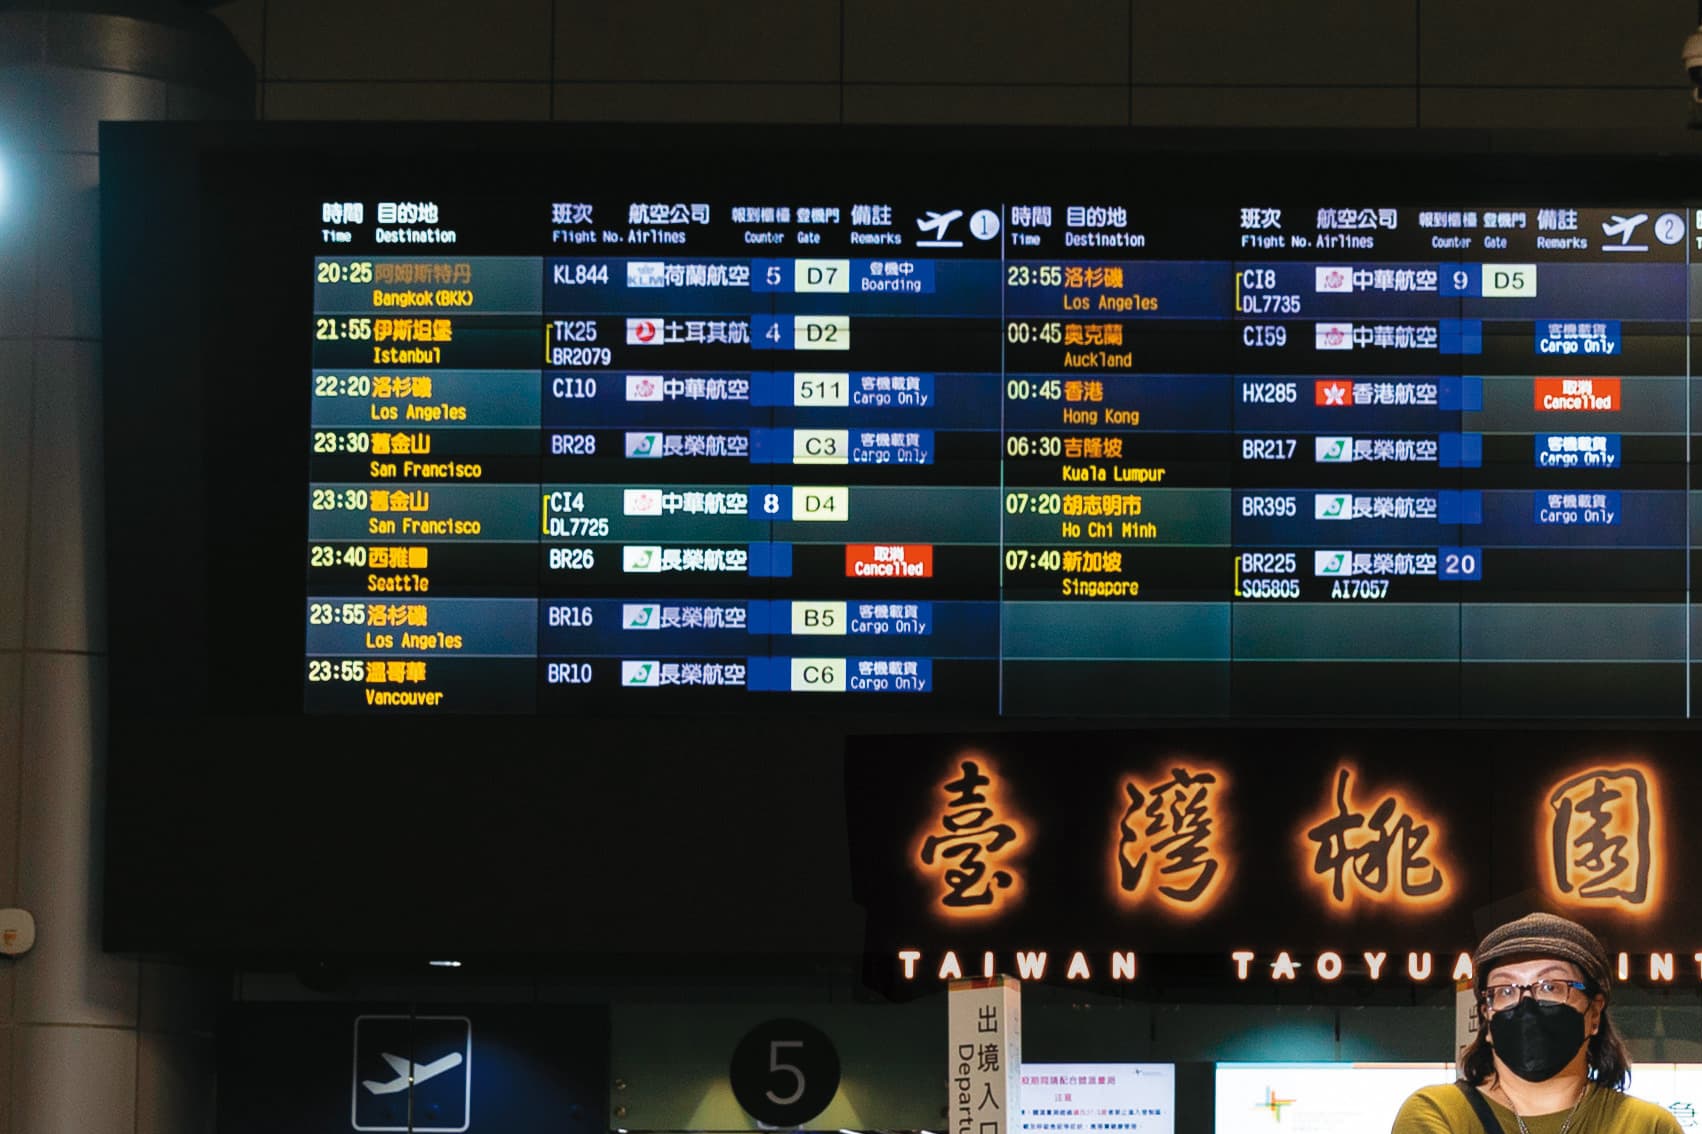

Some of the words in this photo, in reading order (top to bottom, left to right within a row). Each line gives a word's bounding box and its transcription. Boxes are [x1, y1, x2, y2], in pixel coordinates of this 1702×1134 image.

[322, 202, 364, 225] 時間
[377, 201, 439, 224] 目的地
[551, 203, 593, 225] 班次
[628, 203, 710, 225] 航空公司
[796, 207, 840, 224] 登機門
[850, 204, 892, 226] 備註
[321, 229, 352, 243] Time
[375, 227, 457, 244] Destination
[552, 229, 597, 244] Flight
[602, 230, 624, 243] No.
[627, 228, 686, 244] Airlines
[744, 230, 785, 244] Counter
[797, 231, 821, 244] Gate
[850, 231, 902, 245] Remarks
[317, 262, 373, 283] 20:25
[553, 264, 609, 285] KL844
[665, 265, 750, 287] 荷蘭航空
[766, 266, 781, 285] 5
[806, 266, 838, 285] D7
[1007, 266, 1062, 286] 23:55
[1064, 267, 1123, 288] 洛杉磯
[1243, 269, 1276, 290] CI8
[1353, 269, 1438, 292] 中華航空
[1453, 270, 1468, 290] 9
[1494, 272, 1525, 290] D5
[861, 276, 922, 293] Boarding
[373, 289, 474, 308] Bangkok(BKK)
[1063, 294, 1090, 310] Los
[1098, 294, 1158, 312] Angeles
[1242, 294, 1301, 314] DL7735
[316, 318, 372, 340] 21:55
[373, 318, 453, 342] 伊斯坦堡
[553, 320, 597, 342] TK25
[665, 321, 750, 344] 土耳其航
[765, 322, 781, 343] 4
[807, 324, 837, 342] D2
[1007, 322, 1062, 344] 00:45
[1064, 323, 1123, 346] 奧克蘭
[1243, 325, 1287, 347] CI59
[373, 346, 441, 364] Istanbul
[552, 347, 612, 366] BR2079
[1064, 351, 1133, 368] Auckland
[314, 375, 371, 397] 22:20
[372, 376, 432, 398] 洛杉磯
[552, 377, 597, 398] CI10
[664, 379, 749, 400] 中華航空
[800, 381, 841, 400] 511
[1064, 380, 1103, 402] 香港
[1242, 382, 1297, 403] HX285
[1352, 382, 1438, 405] 香港航空
[853, 390, 892, 406] Cargo
[897, 391, 928, 407] Only
[1543, 394, 1612, 410] Cancelled
[371, 404, 398, 420] Los
[406, 403, 467, 422] Angeles
[1063, 408, 1098, 425] Hong
[1105, 408, 1140, 426] Kong
[313, 432, 370, 453] 23:30
[551, 434, 596, 455] BR28
[664, 435, 749, 457] 長榮航空
[805, 437, 836, 456] C3
[1007, 436, 1062, 457] 06:30
[1063, 437, 1123, 458] 吉隆坡
[1242, 439, 1297, 460] BR217
[370, 460, 397, 478] San
[403, 460, 482, 478] Francisco
[1062, 465, 1107, 482] Kuala
[1113, 465, 1166, 483] Lumpur
[550, 492, 584, 513] CI4
[763, 493, 780, 514] 8
[805, 495, 835, 513] D4
[1006, 493, 1061, 515] 07:20
[1062, 494, 1142, 516] 胡志明市
[1242, 496, 1297, 517] BR395
[1352, 497, 1437, 519] 長榮航空
[551, 518, 610, 537] DL7725
[1062, 522, 1081, 538] Ho
[1087, 521, 1113, 538] Chi
[1121, 522, 1157, 538] Minh
[310, 545, 367, 567] 23:40
[549, 548, 595, 570] BR26
[1005, 550, 1061, 571] 07:40
[1062, 550, 1122, 573] 新加坡
[1242, 552, 1297, 574] BR225
[1446, 554, 1475, 574] 20
[855, 561, 924, 576] Cancelled
[367, 574, 429, 592] Seattle
[1062, 577, 1139, 597] Singapore
[1242, 578, 1300, 599] SQ5805
[1331, 579, 1390, 599] AI7057
[548, 606, 593, 627] BR16
[804, 609, 835, 628] B5
[308, 660, 365, 682] 23:55
[547, 663, 593, 684] BR10
[802, 666, 835, 685] C6
[850, 675, 889, 691] Cargo
[894, 675, 926, 692] Only
[365, 688, 444, 706] Vancouver
[898, 951, 1135, 980] TAIWAN
[1232, 951, 1473, 980] TAOYUA
[764, 1039, 806, 1105] 5
